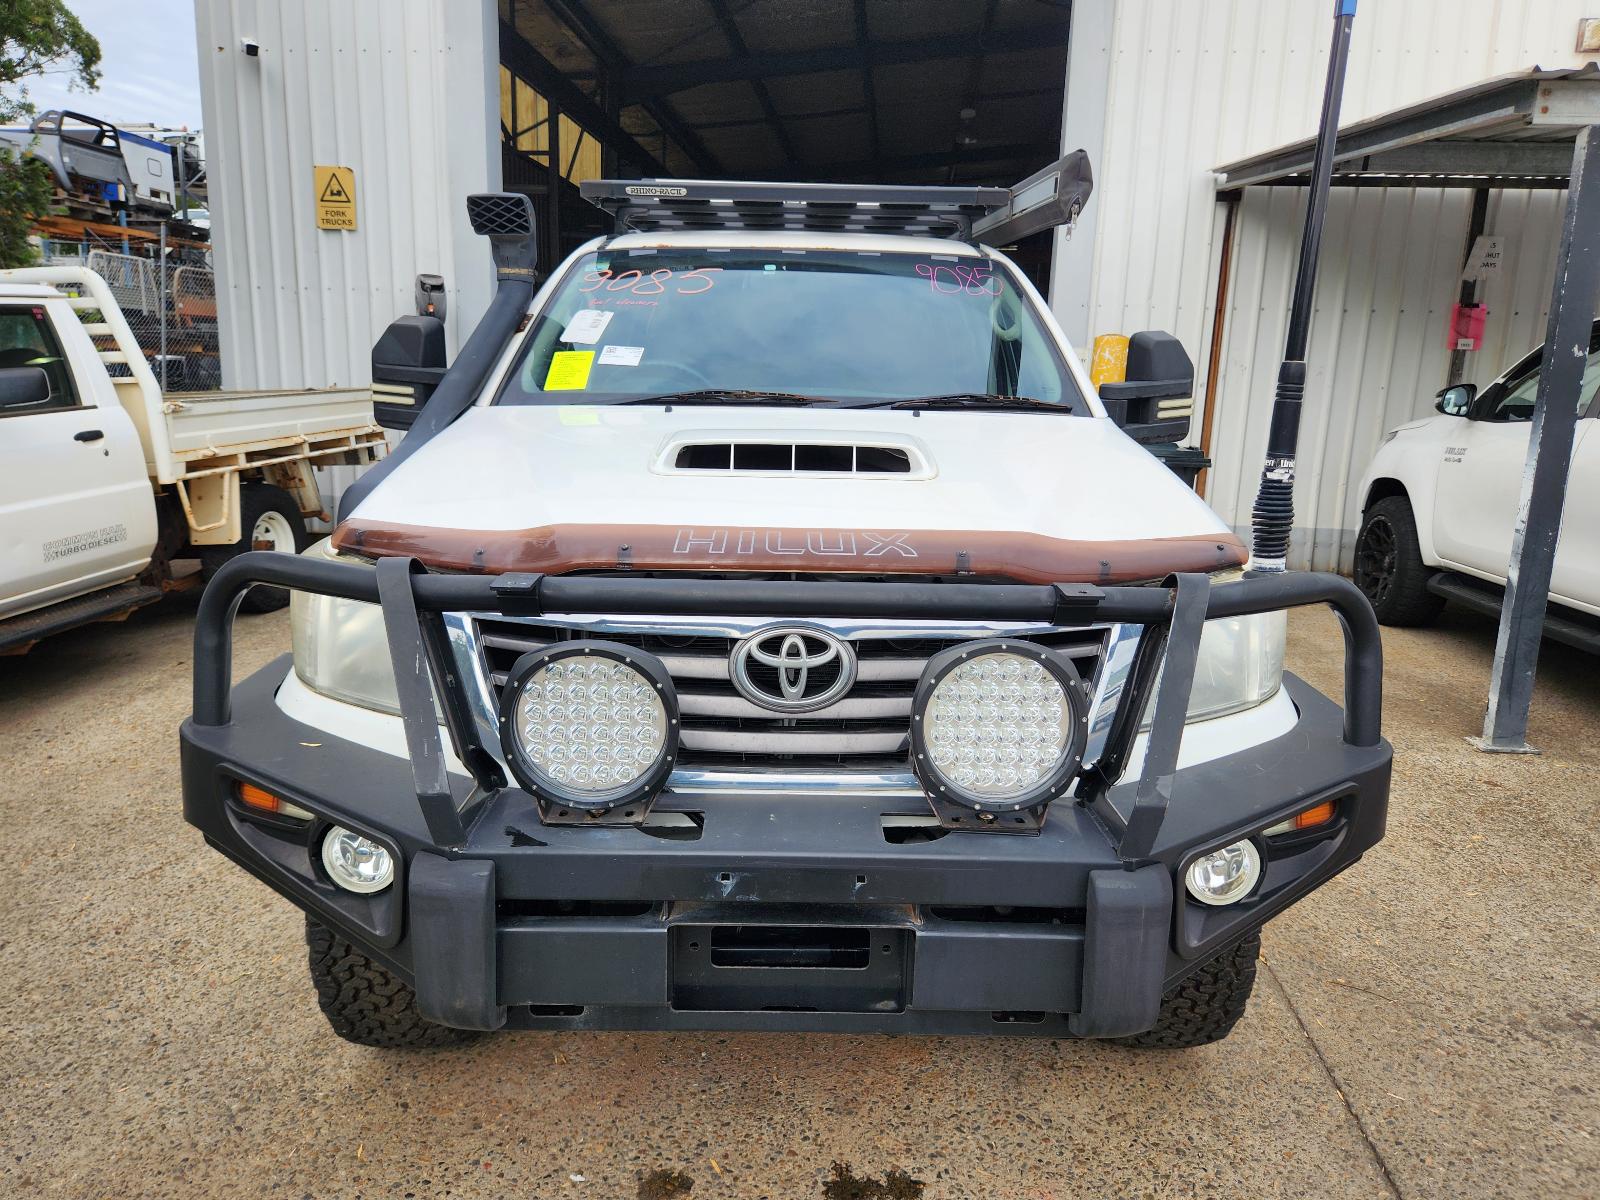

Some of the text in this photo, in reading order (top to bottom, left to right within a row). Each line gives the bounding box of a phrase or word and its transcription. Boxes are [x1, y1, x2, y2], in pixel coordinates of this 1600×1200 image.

[630, 187, 682, 195] RHINO-RACK
[578, 268, 724, 295] 9085
[915, 264, 1004, 296] 9085
[87, 536, 119, 549] DIESEL
[673, 528, 918, 557] HILUX
